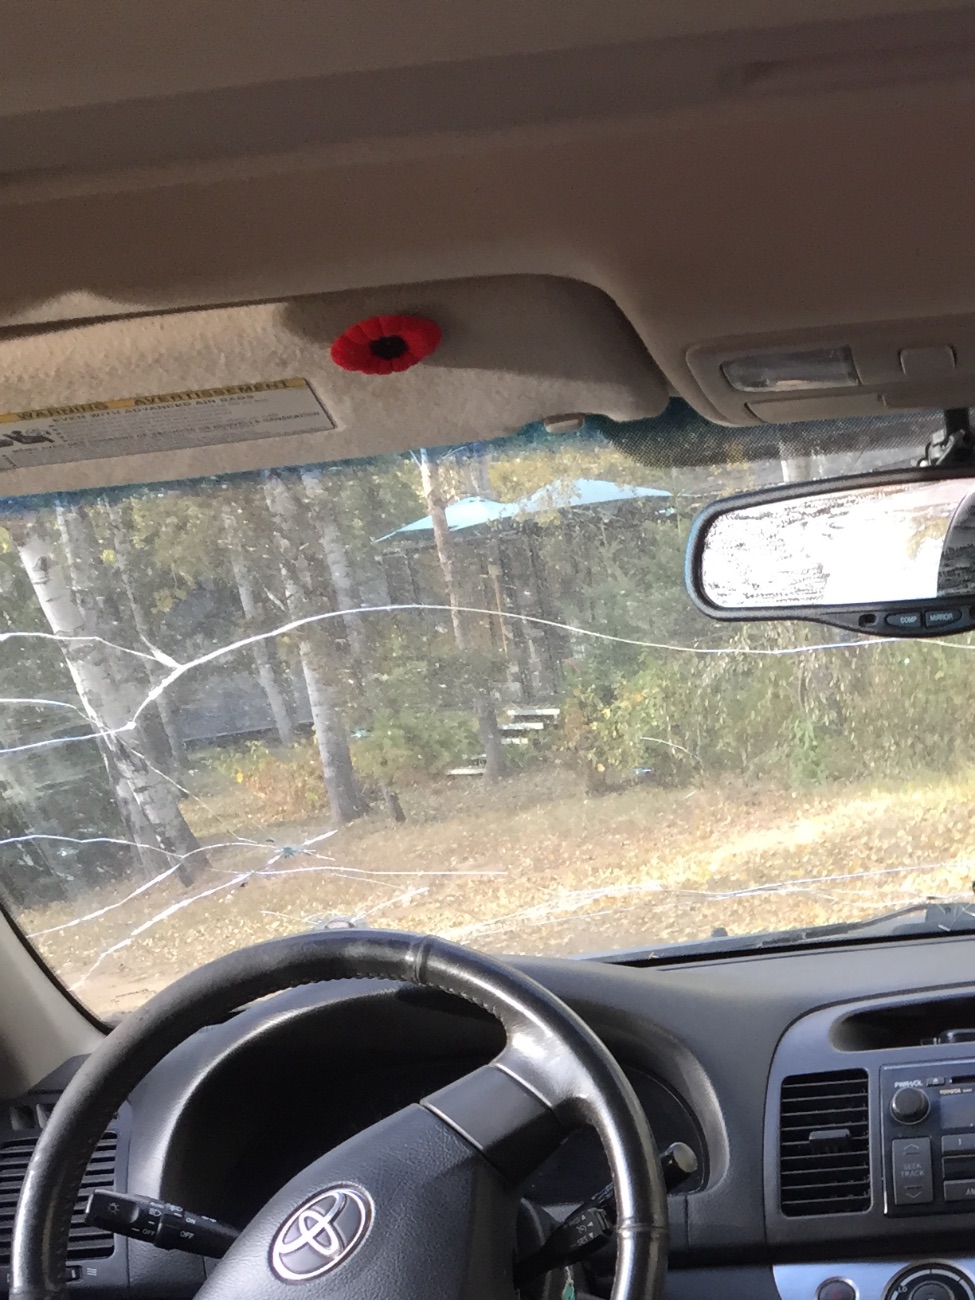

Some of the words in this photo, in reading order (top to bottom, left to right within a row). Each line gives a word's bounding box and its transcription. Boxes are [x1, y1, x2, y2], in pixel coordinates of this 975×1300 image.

[957, 1138, 962, 1146] 1
[900, 1169, 924, 1178] TRACK
[185, 1217, 196, 1225] ON
[142, 1227, 156, 1237] OFF
[179, 1230, 196, 1240] OFF
